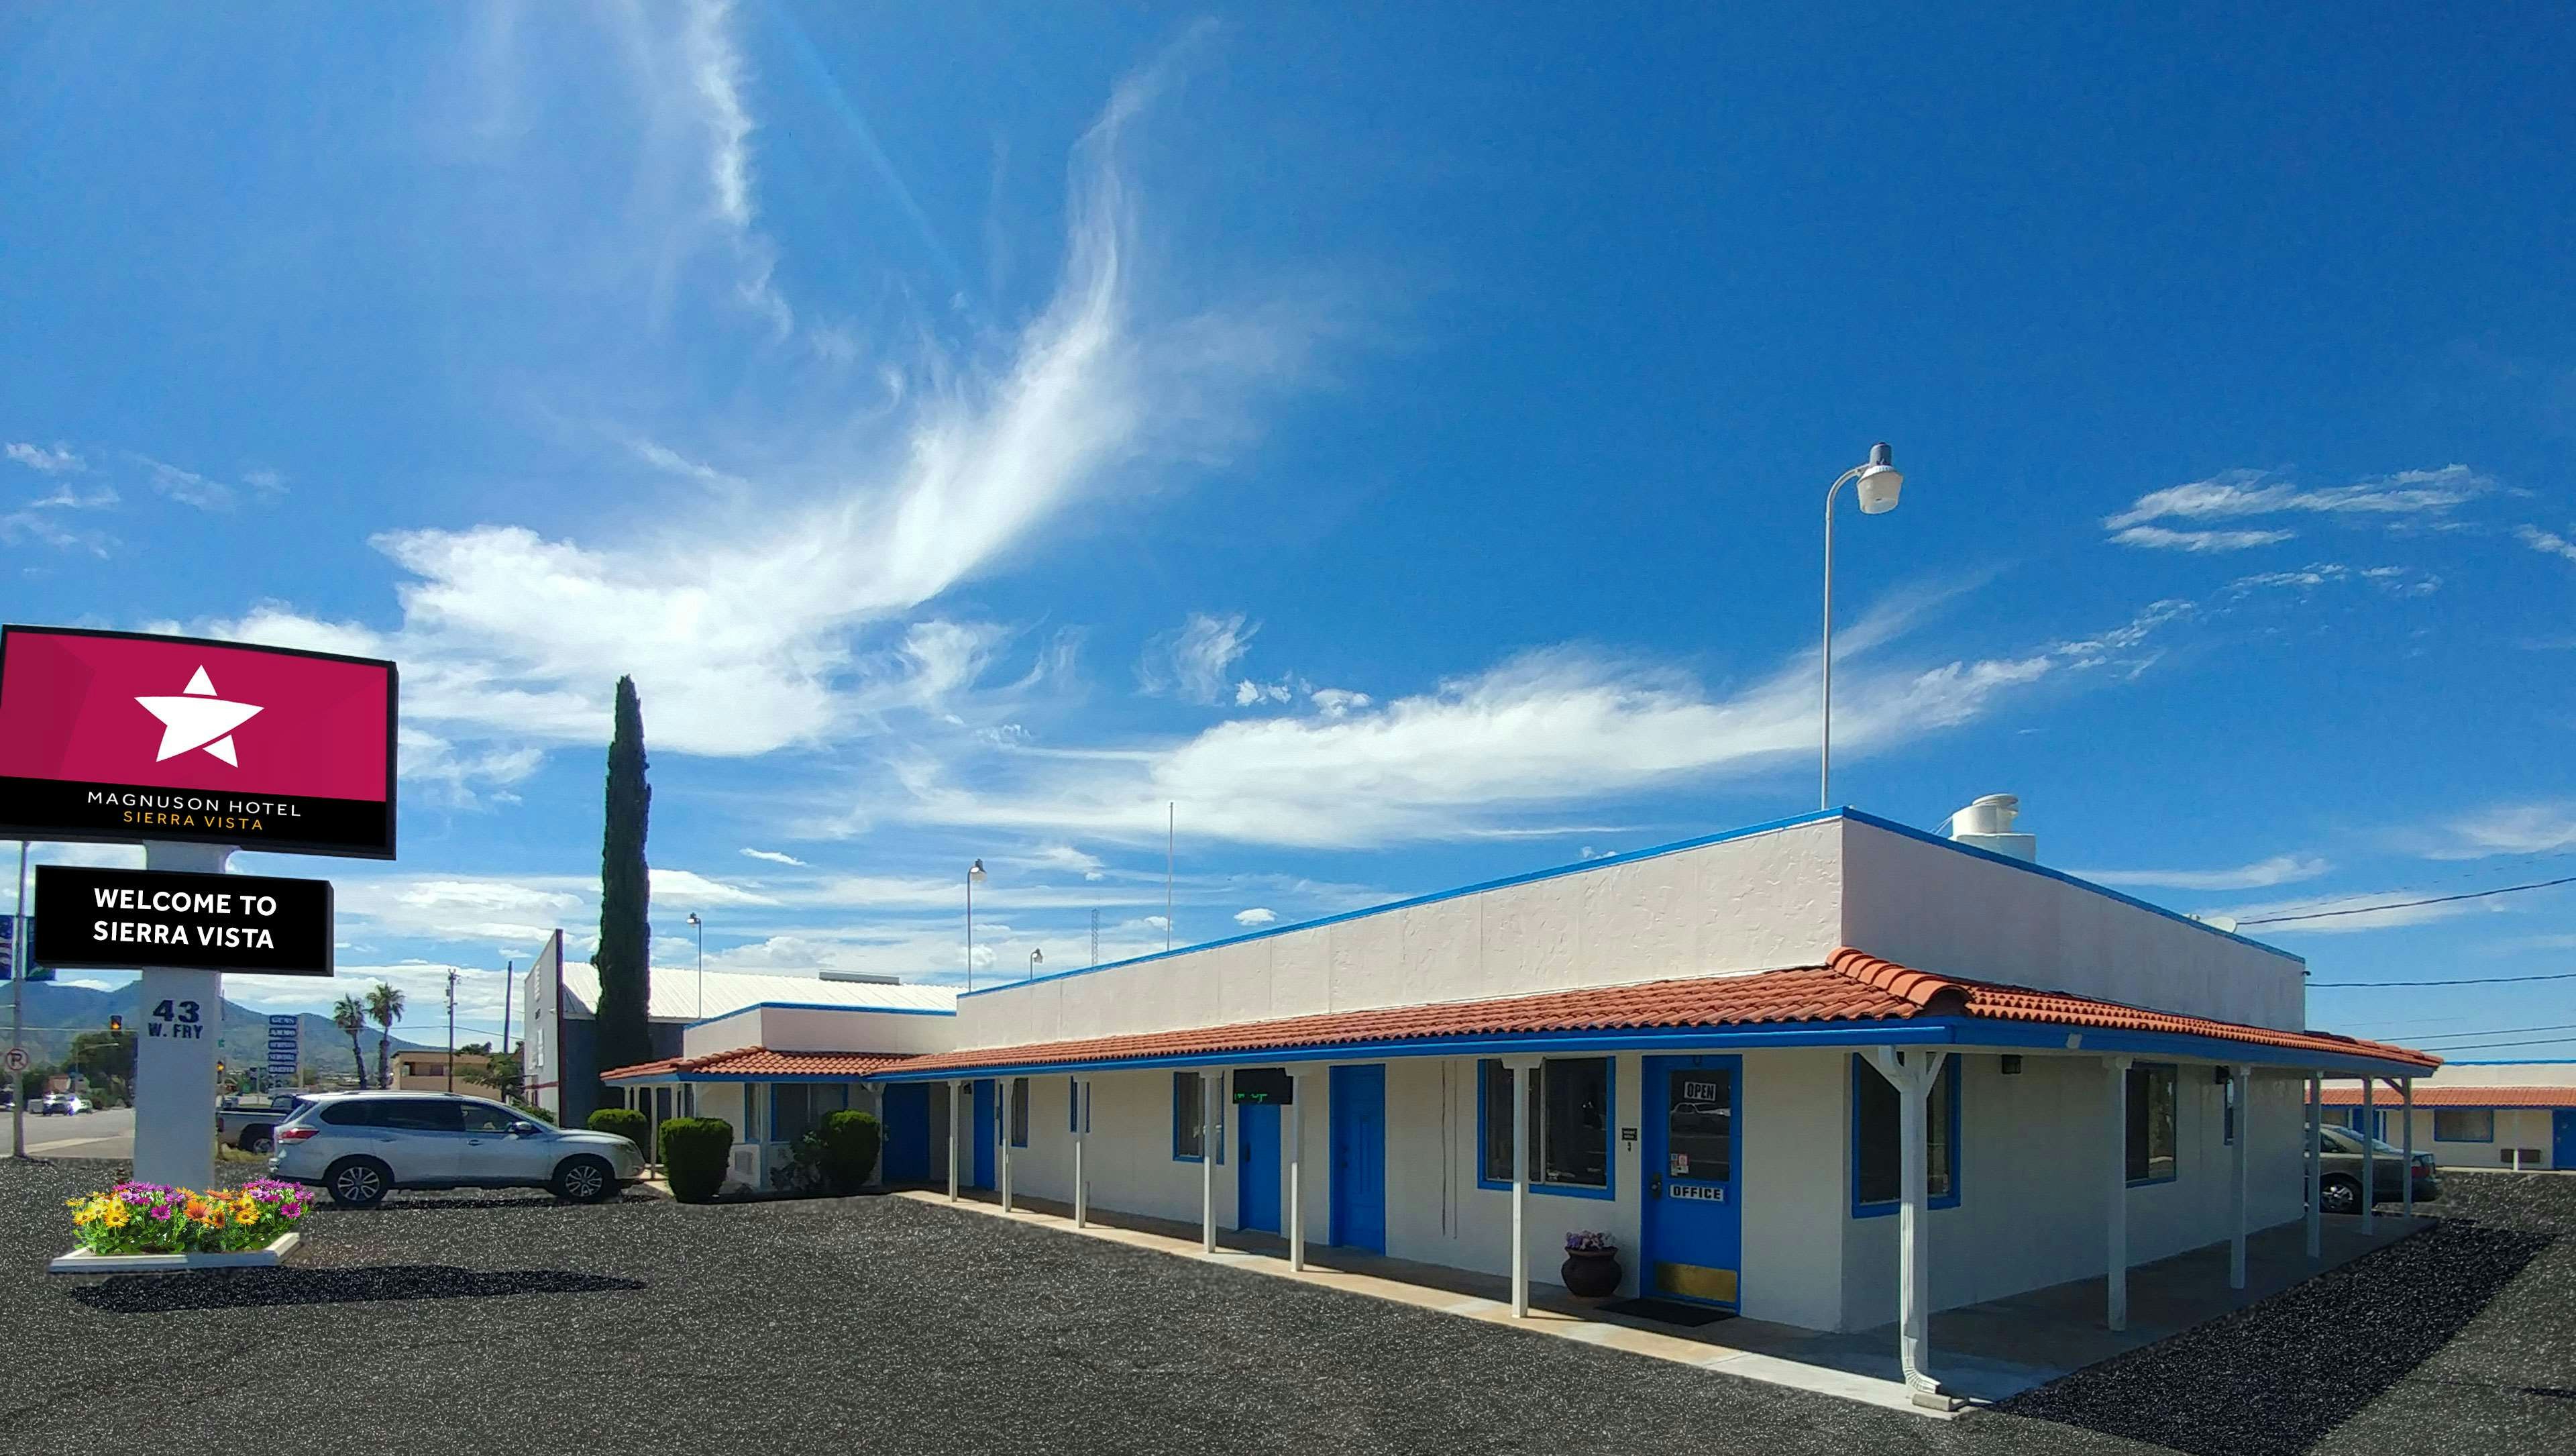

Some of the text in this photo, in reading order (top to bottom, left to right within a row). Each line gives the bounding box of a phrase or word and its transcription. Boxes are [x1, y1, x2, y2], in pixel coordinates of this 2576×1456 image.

[88, 791, 301, 817] MAGNUSON HOTEL
[123, 811, 263, 830] SIERRA VISTA
[94, 888, 277, 917] WELCOME TO
[93, 920, 274, 949] SIERRA VISTA
[152, 1000, 200, 1023] 43
[148, 1023, 203, 1039] W. FRY
[1687, 1083, 1714, 1099] OPEN
[1673, 1186, 1721, 1200] OFFICE
